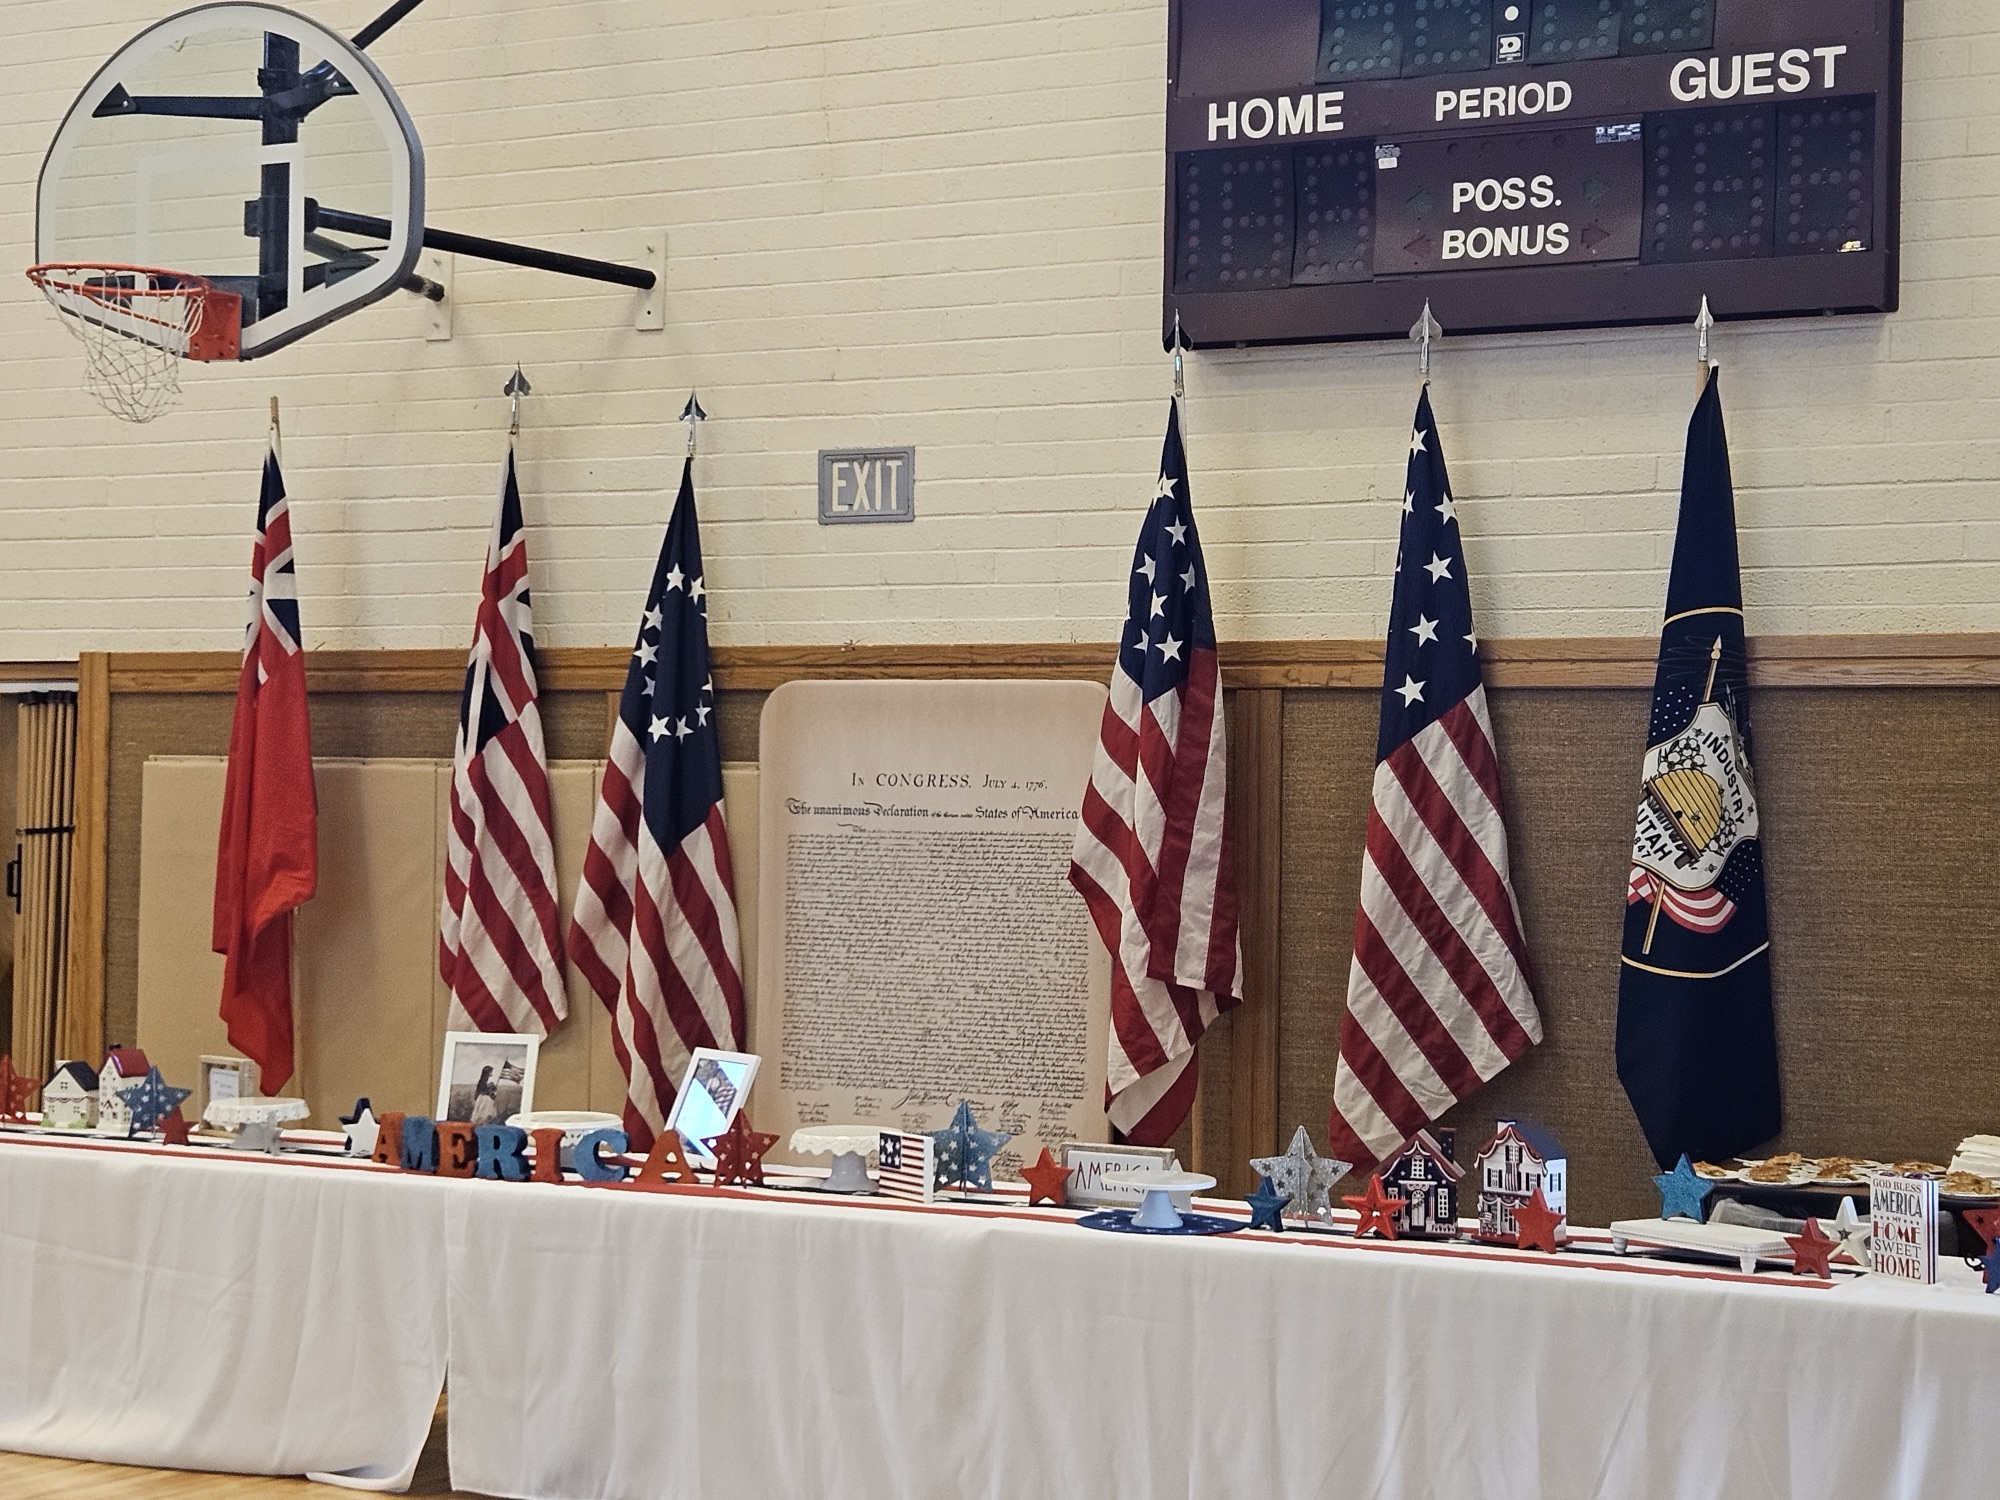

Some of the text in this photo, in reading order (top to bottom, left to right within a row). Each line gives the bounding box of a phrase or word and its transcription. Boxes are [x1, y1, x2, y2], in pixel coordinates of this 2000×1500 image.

[1669, 45, 1847, 102] GUEST
[1207, 91, 1345, 142] HOME
[1435, 80, 1572, 122] PERIOD
[1452, 174, 1563, 213] POSS.
[1441, 222, 1570, 260] BONUS
[832, 460, 903, 512] EXIT
[1702, 731, 1745, 824] INDUSTRY
[785, 797, 812, 815] The
[813, 803, 871, 816] unanimous
[863, 801, 929, 818] Declaration
[975, 805, 1009, 819] States
[1011, 806, 1022, 822] of
[1021, 805, 1080, 820] America
[1637, 808, 1673, 861] UTAH
[372, 1111, 700, 1185] AMERICA
[1873, 1178, 1922, 1194] GOD BLESS
[1873, 1188, 1923, 1218] AMERICA
[1873, 1221, 1921, 1245] HOME
[1874, 1238, 1921, 1259] SWEET
[1874, 1252, 1922, 1280] HOME
